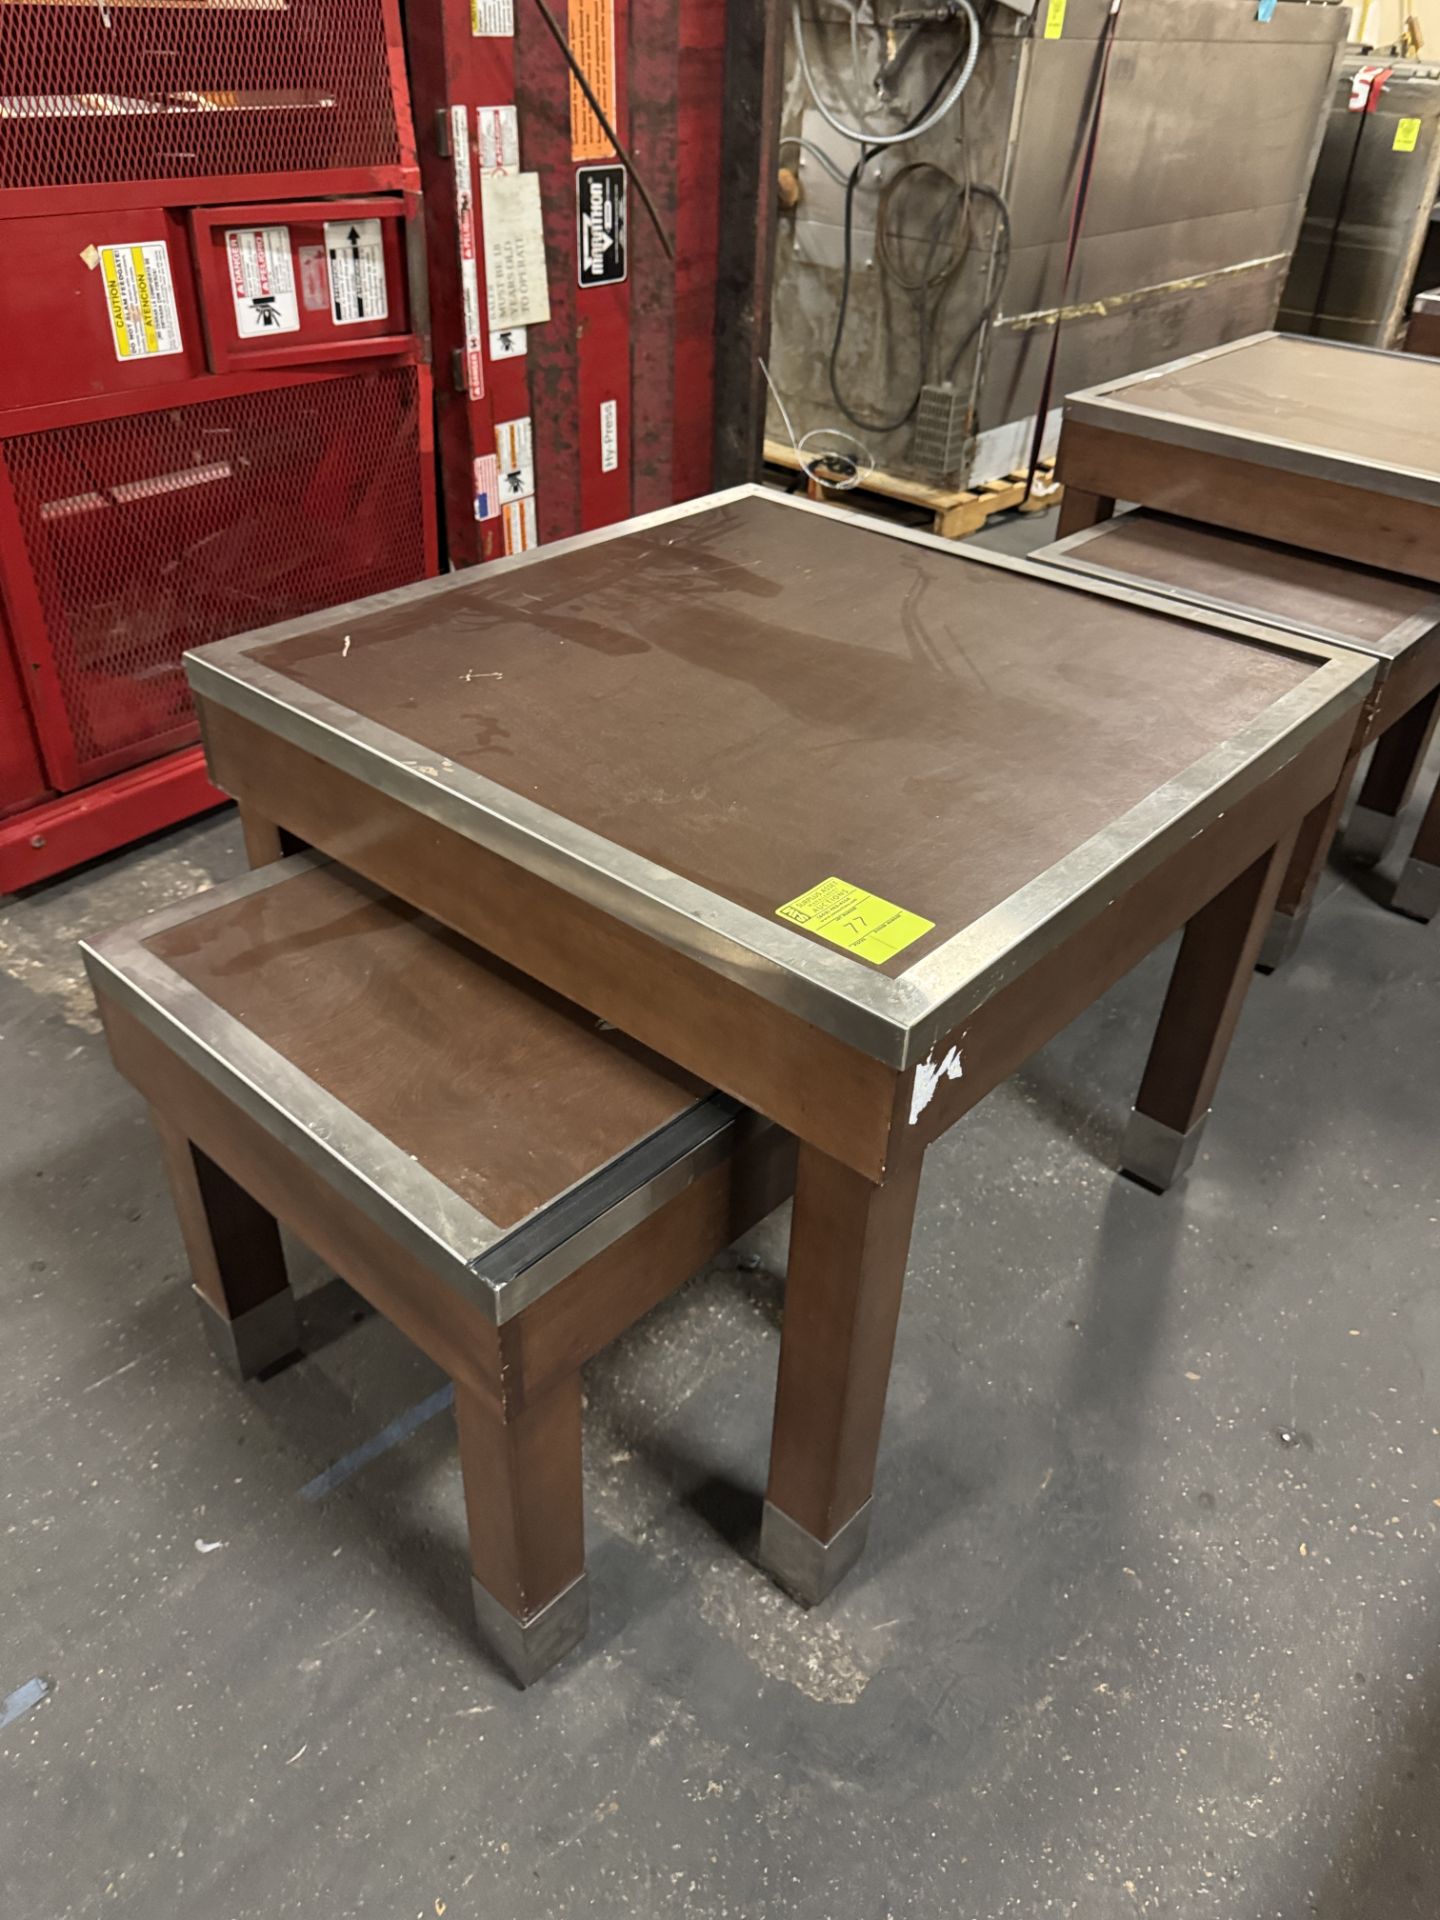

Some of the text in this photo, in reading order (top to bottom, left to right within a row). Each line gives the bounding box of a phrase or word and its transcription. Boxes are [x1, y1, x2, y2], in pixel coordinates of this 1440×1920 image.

[229, 238, 243, 283] DANGER
[254, 235, 267, 281] PELIGRO
[492, 242, 507, 318] MUST BE 18
[503, 239, 518, 315] YEARS OLD
[514, 236, 530, 312] TO OPERATE
[108, 279, 124, 328] CAUTION
[122, 298, 131, 320] SLAM
[126, 322, 134, 340] NOT
[130, 341, 136, 354] DO
[810, 888, 850, 913] AUCTIONS
